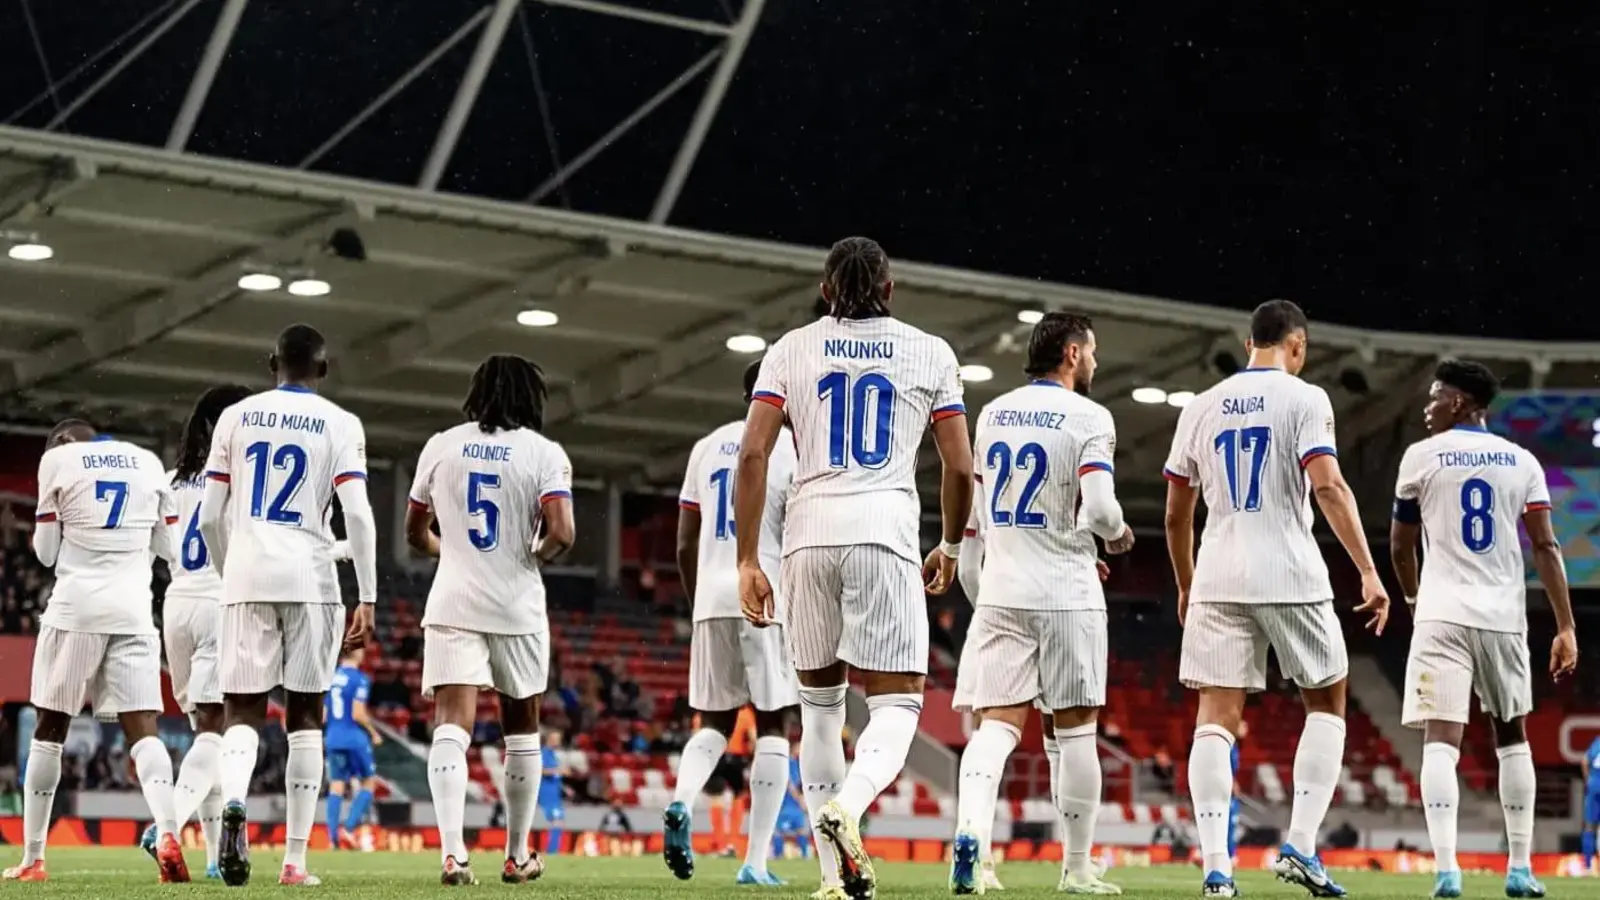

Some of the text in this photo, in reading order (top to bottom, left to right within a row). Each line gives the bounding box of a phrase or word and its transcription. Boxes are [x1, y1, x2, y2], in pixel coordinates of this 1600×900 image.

[824, 339, 893, 359] NKUNKU
[242, 410, 326, 435] KOLO MUANI
[817, 371, 897, 470] 10
[1222, 396, 1265, 415] SALIBA
[82, 455, 139, 470] DEMBELE
[462, 443, 512, 462] KOUNDE
[1214, 426, 1271, 513] 17
[1438, 452, 1517, 467] TCHOUAMENI
[95, 480, 129, 529] 7
[245, 441, 308, 526] 12
[467, 472, 502, 552] 5
[986, 441, 1049, 528] 22
[182, 500, 210, 573] 6
[1461, 478, 1496, 555] 8
